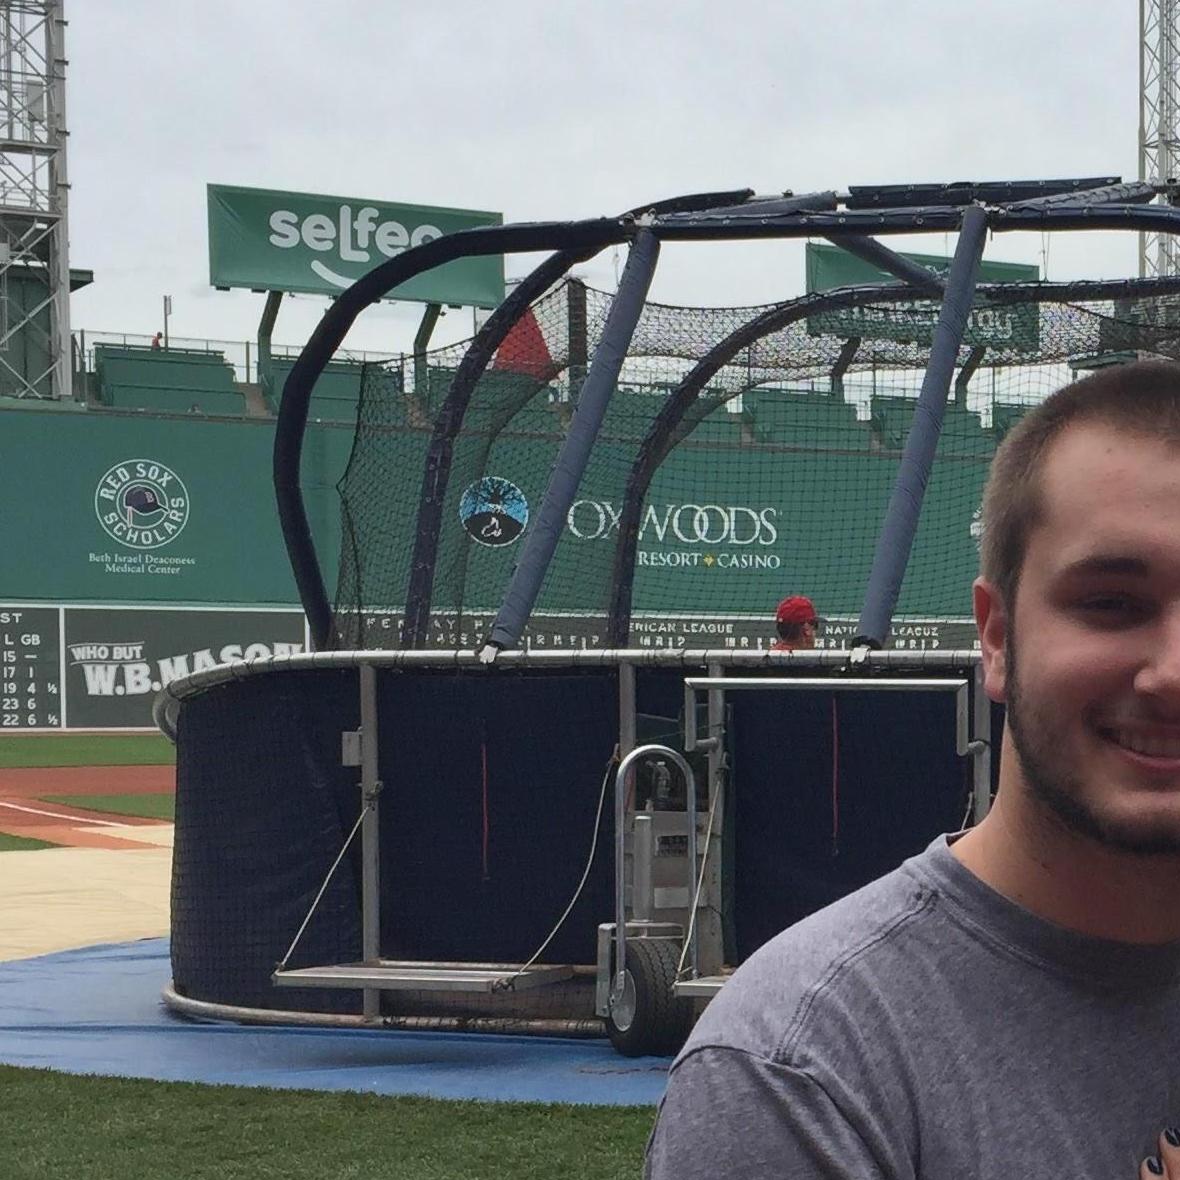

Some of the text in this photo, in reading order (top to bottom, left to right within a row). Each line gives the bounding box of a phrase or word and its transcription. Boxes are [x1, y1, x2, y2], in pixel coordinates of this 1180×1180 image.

[100, 463, 173, 500] RED SOX
[103, 497, 185, 545] SCHOLARS
[567, 500, 778, 545] OXWOODS
[638, 551, 781, 569] RESORT CASINO
[683, 624, 734, 634] LEAGUE
[21, 635, 41, 646] GB
[2, 651, 17, 662] 15
[71, 645, 143, 660] WHO BUT
[3, 667, 15, 678] 17
[3, 683, 17, 694] 19
[27, 683, 36, 694] 4
[2, 699, 36, 710] 23 6
[2, 715, 19, 726] 22
[27, 715, 36, 726] 6
